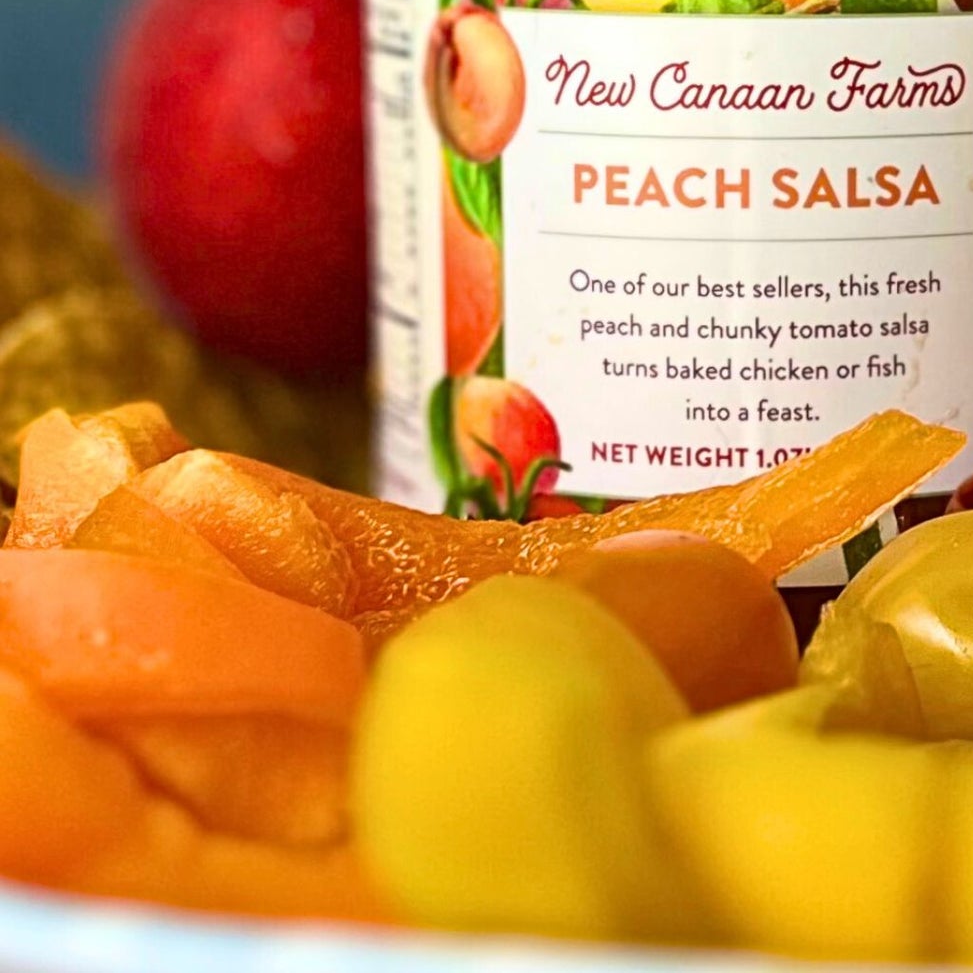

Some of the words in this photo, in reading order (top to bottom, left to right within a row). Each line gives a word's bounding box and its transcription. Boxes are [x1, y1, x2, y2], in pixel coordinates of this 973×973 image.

[545, 54, 635, 107] New
[650, 61, 815, 111] Canaan
[827, 56, 965, 112] Farms
[574, 163, 750, 209] PEACH
[772, 165, 940, 209] SALSA
[570, 269, 615, 294] One
[623, 273, 647, 295] of
[652, 282, 689, 296] our
[697, 275, 745, 298] best
[753, 275, 830, 302] sellers,
[839, 274, 879, 297] this
[886, 270, 940, 294] fresh
[581, 314, 642, 340] peach
[650, 316, 689, 338] and
[697, 317, 782, 348] chunky
[789, 320, 872, 339] tomato
[880, 313, 929, 336] salsa
[603, 358, 658, 378] turns
[666, 357, 731, 380] baked
[740, 358, 828, 381] chicken
[837, 364, 860, 379] or
[867, 354, 905, 377] fish
[686, 399, 730, 421] into
[738, 408, 748, 421] a
[757, 399, 819, 422] feast.
[592, 442, 638, 463] NET
[645, 445, 748, 467] WEIGHT
